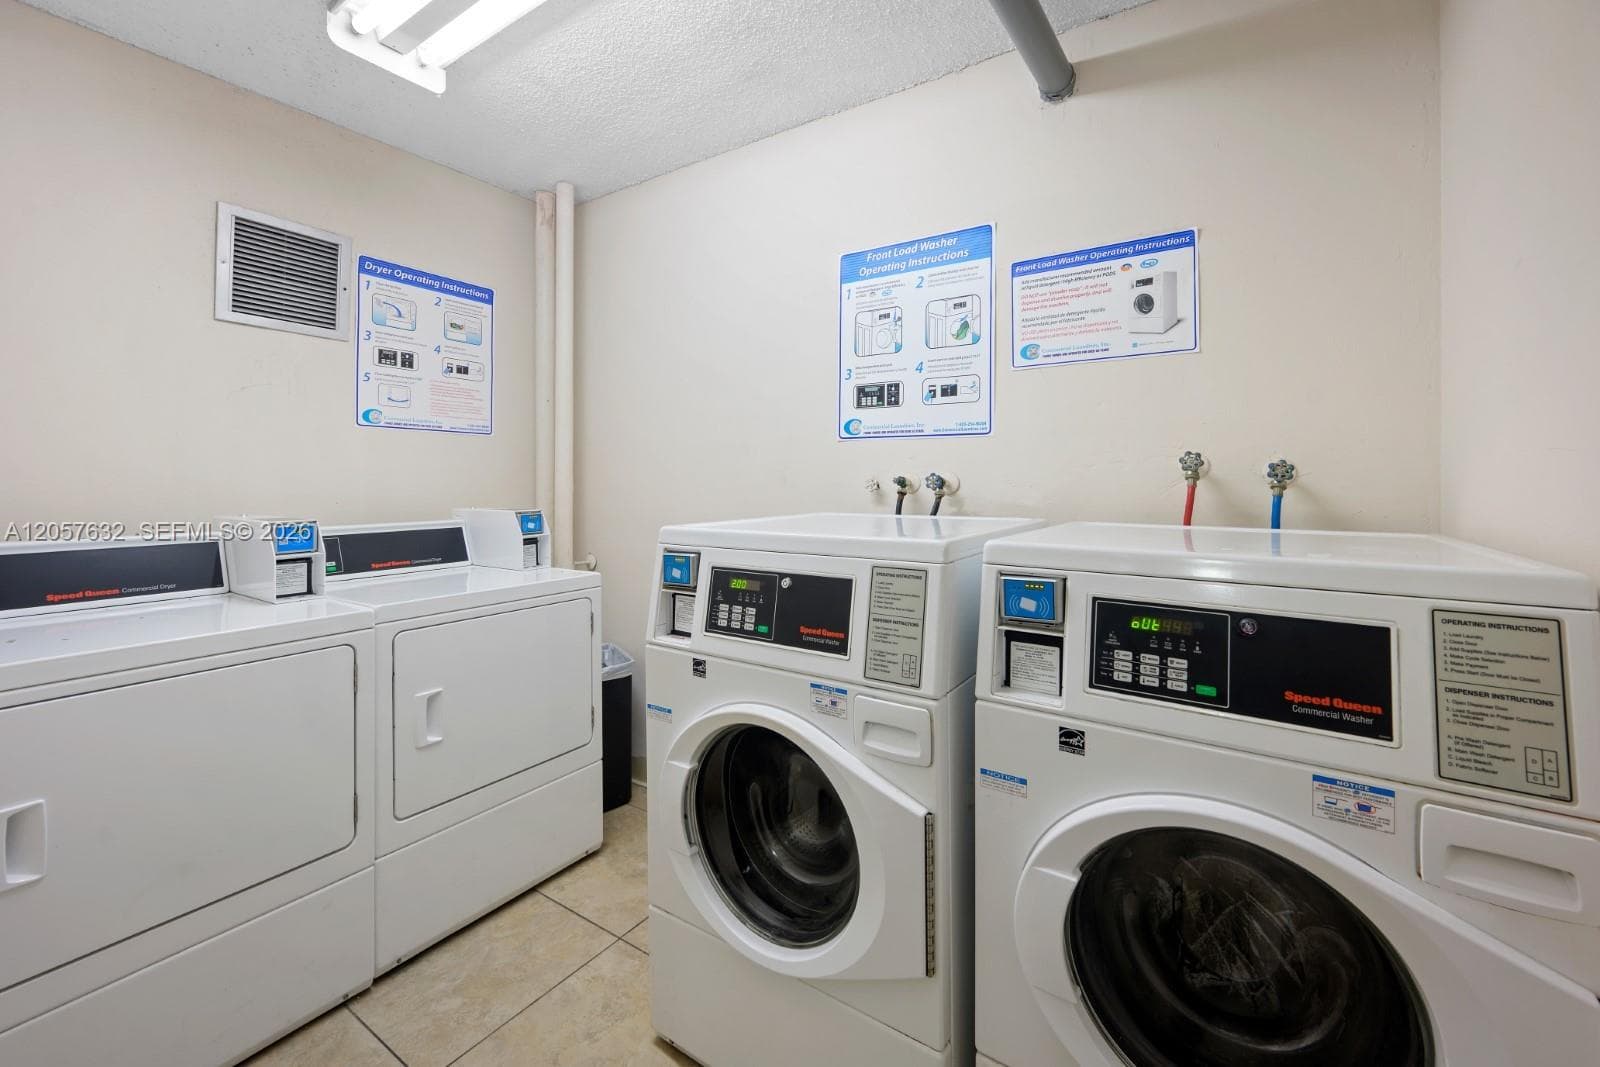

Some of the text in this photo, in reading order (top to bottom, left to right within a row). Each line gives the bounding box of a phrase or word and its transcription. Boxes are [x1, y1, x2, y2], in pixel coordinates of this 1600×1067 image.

[866, 236, 958, 263] Front Load Washer
[1015, 235, 1191, 273] Front Load Washer Operating Instructions
[859, 249, 969, 277] Operating Instructions
[364, 261, 393, 276] Dryer
[394, 269, 440, 289] Operating
[441, 281, 489, 300] Instructions
[365, 280, 371, 290] 1
[915, 276, 924, 289] 2
[846, 289, 852, 300] 1
[434, 297, 442, 307] 2
[363, 330, 372, 341] 3
[433, 345, 441, 355] 4
[915, 361, 924, 374] 4
[362, 371, 371, 382] 5
[845, 369, 852, 380] 3
[371, 561, 391, 570] Speed
[391, 559, 411, 568] Queen
[45, 583, 177, 602] Speed Queen Commercial Dryer
[800, 626, 845, 639] Speed Queen
[1441, 618, 1550, 634] OPERATING INSTRUCTIONS
[1284, 690, 1383, 715] Speed Queen
[1444, 686, 1554, 707] DISPENSER INSTRUCTIONS
[1292, 704, 1374, 725] Commercial Washer
[986, 770, 1019, 783] NOTICE
[1336, 780, 1370, 792] NOTICE
